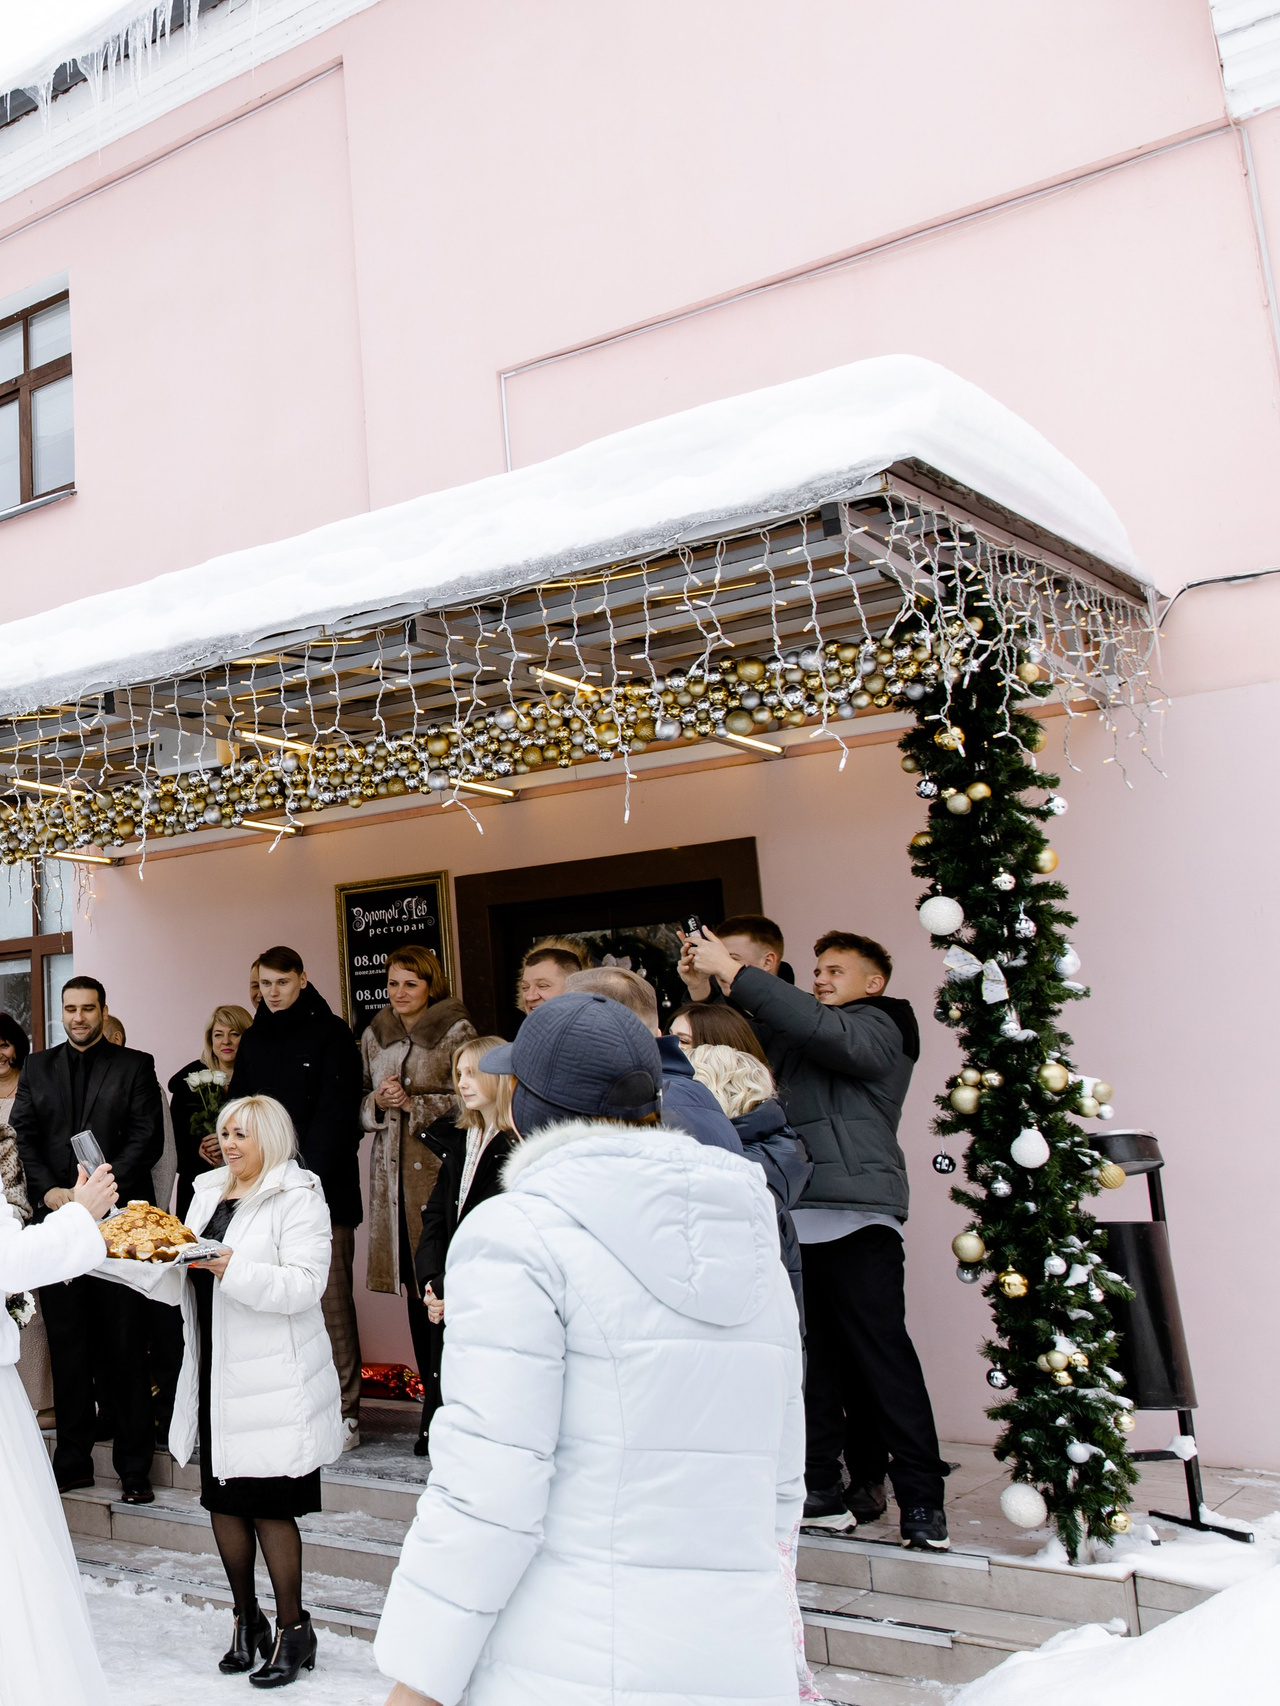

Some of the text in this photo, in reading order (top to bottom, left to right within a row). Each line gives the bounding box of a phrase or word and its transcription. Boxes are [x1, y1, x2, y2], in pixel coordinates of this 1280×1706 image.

[351, 896, 434, 931] Золотой Лев
[369, 923, 424, 937] ресторан
[354, 953, 387, 967] 08.00
